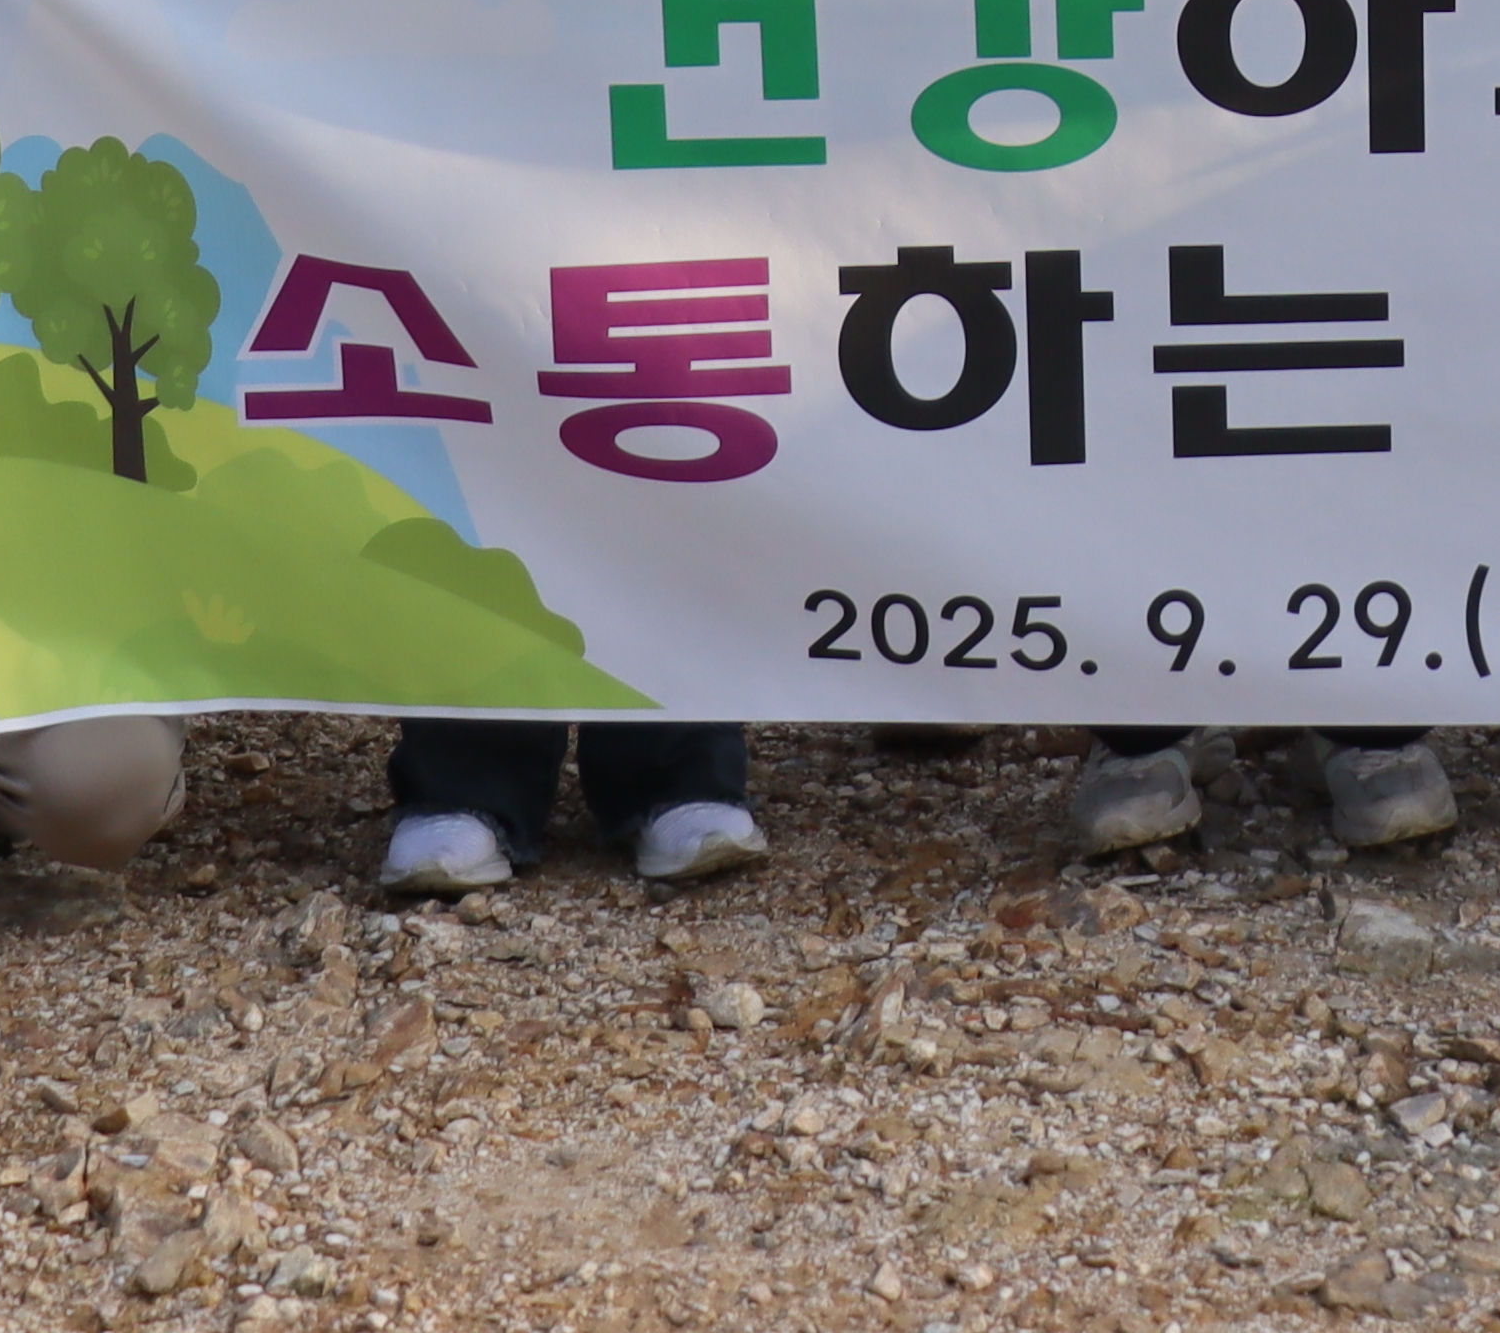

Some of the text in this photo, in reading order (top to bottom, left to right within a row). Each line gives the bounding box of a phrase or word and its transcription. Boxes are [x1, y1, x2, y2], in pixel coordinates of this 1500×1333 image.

[245, 245, 1405, 484] 소통하는
[804, 590, 1099, 676] 2025.
[1147, 590, 1237, 677] 9.
